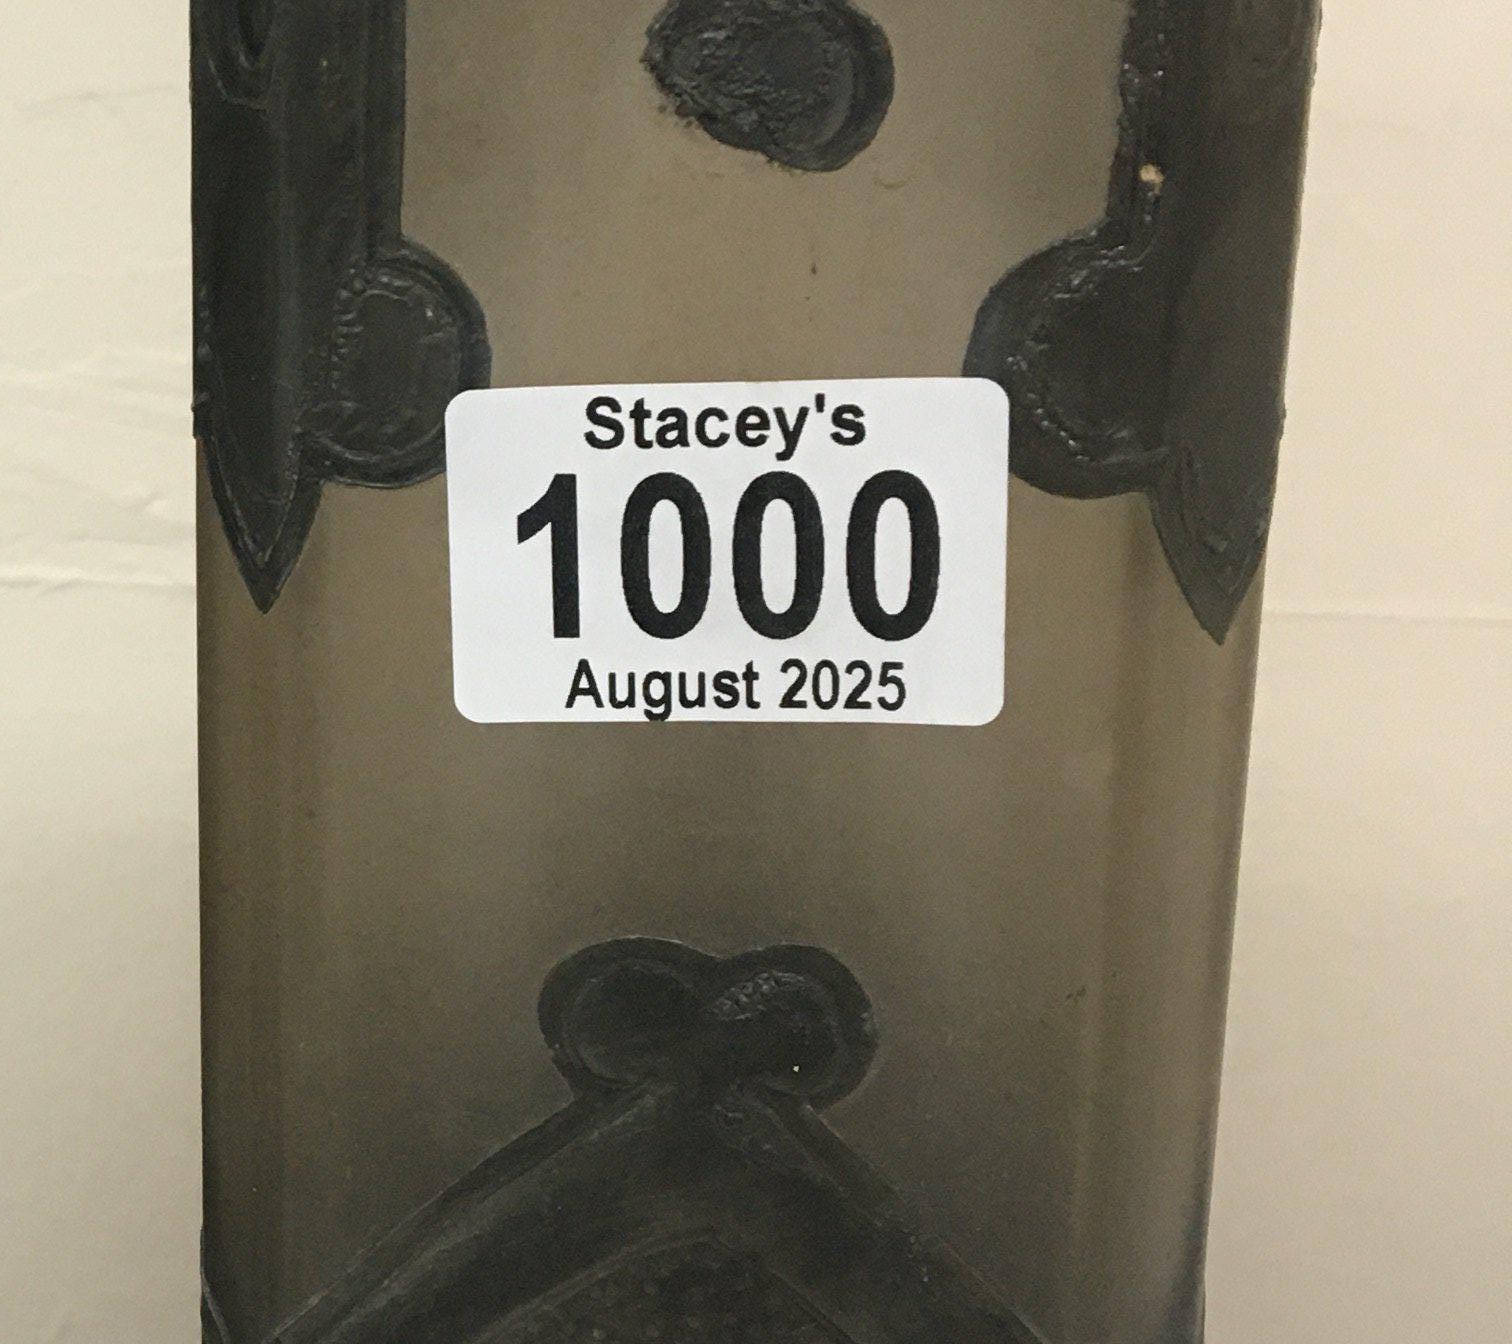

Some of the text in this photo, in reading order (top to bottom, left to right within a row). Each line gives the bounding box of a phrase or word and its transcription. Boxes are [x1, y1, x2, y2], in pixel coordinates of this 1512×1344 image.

[584, 392, 867, 462] Stacey's
[516, 469, 941, 642] 1000
[564, 658, 906, 722] August 2025
